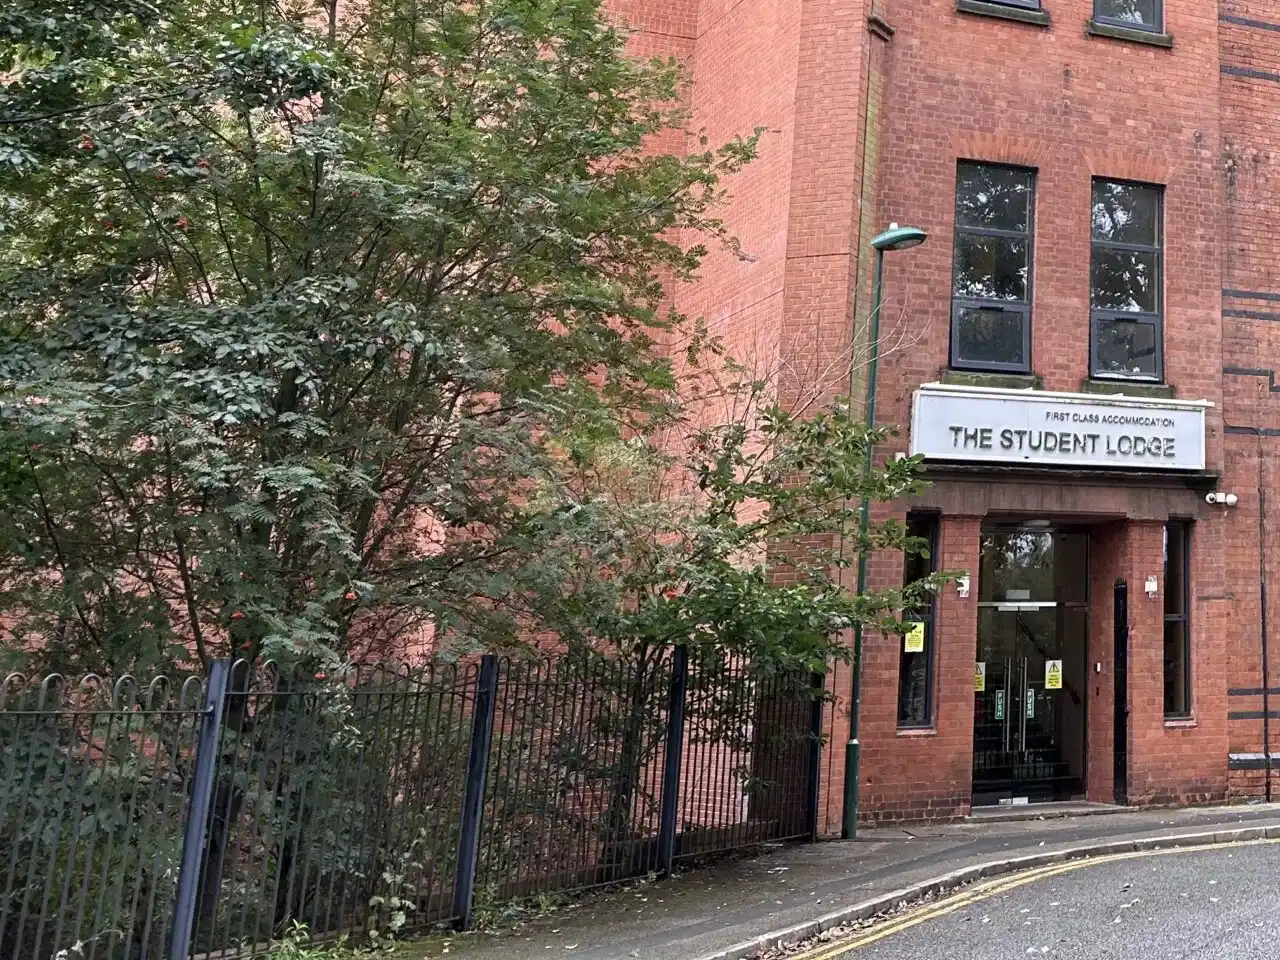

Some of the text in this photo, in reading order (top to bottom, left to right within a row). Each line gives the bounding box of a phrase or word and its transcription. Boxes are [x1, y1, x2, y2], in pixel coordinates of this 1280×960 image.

[1046, 411, 1175, 428] FIRST CLASS ACCOMMODATION
[949, 425, 1176, 457] THE STUDENT LODGE
